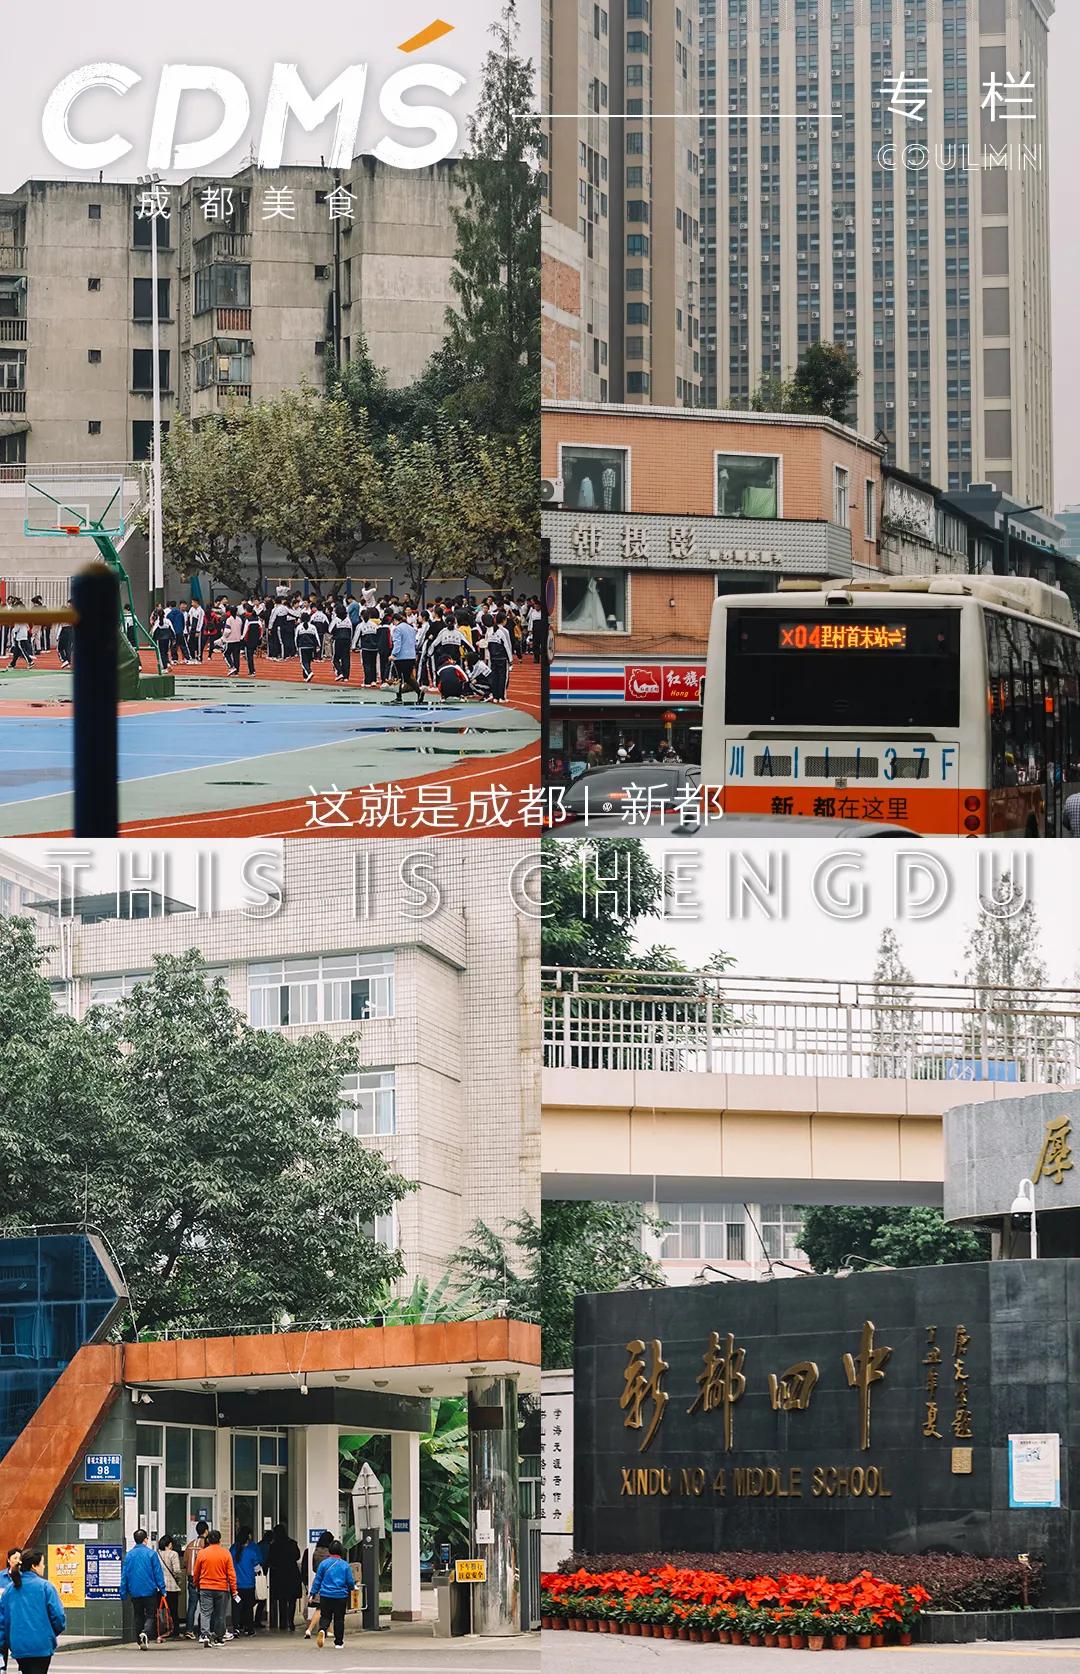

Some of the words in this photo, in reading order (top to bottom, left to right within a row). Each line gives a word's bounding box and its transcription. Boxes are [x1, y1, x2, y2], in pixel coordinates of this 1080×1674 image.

[667, 670, 699, 687] 红旗
[1032, 1114, 1073, 1184] 厚
[619, 1320, 895, 1452] 新都四中
[97, 1465, 110, 1475] 98
[620, 1466, 672, 1496] XINDU
[680, 1467, 705, 1496] NO
[712, 1468, 726, 1496] 4
[733, 1467, 802, 1497] MIDDLE
[811, 1466, 892, 1497] SCHOOL
